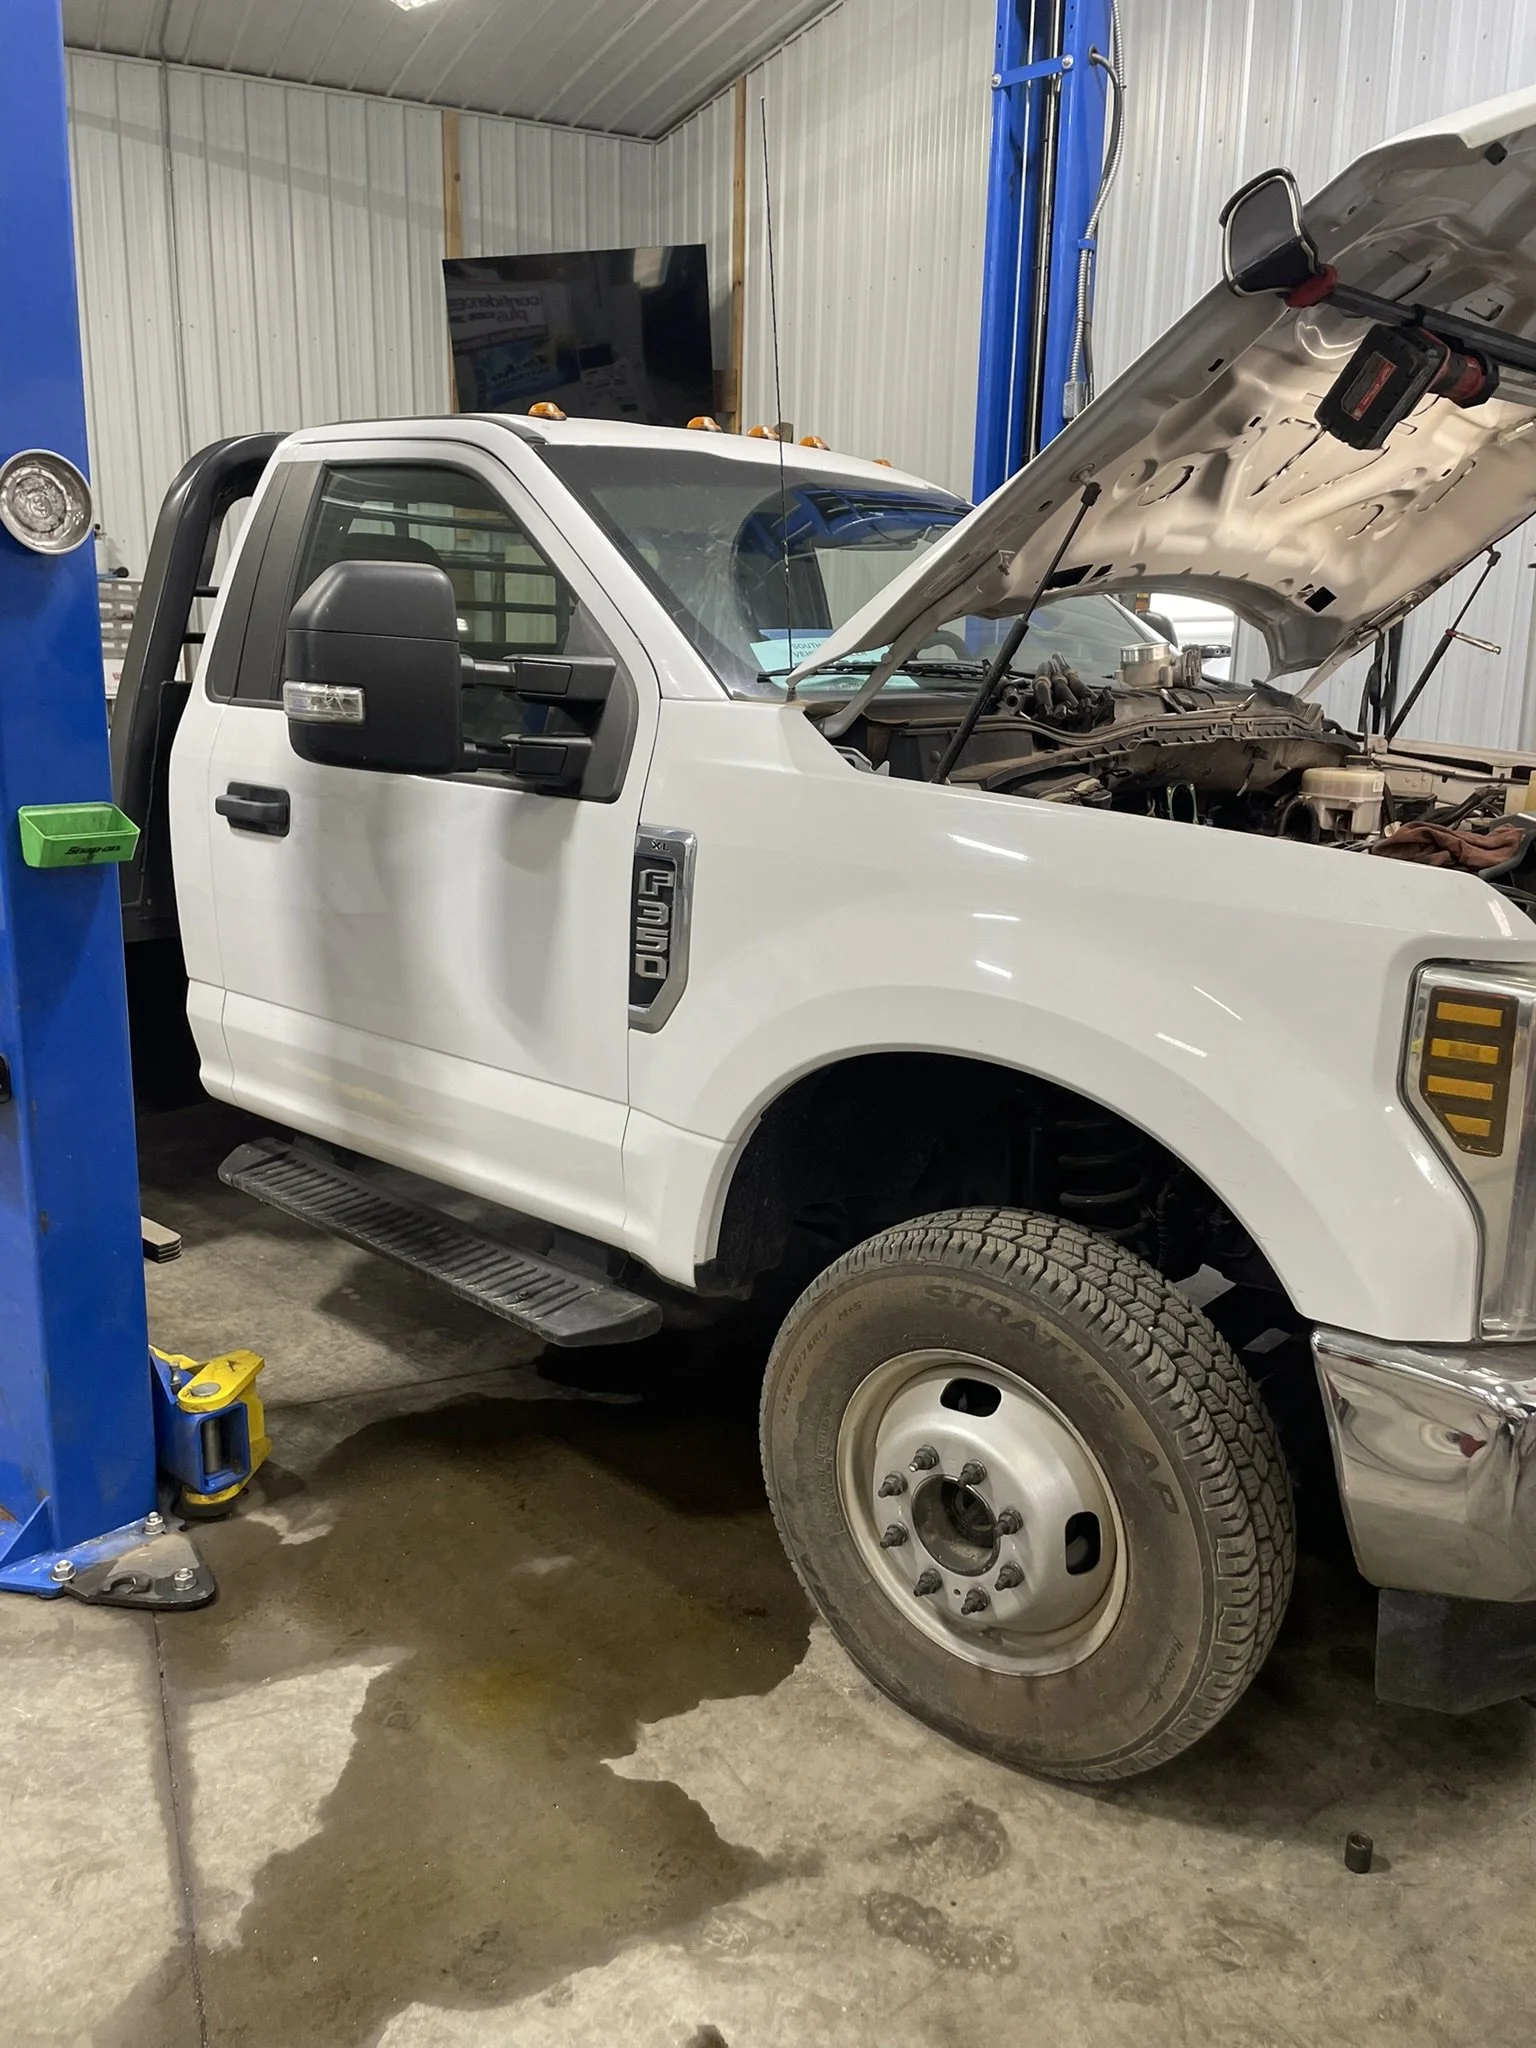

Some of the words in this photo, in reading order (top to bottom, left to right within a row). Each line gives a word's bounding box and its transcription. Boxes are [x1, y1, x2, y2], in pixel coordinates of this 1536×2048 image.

[65, 845, 121, 856] Snap-on
[652, 840, 670, 851] XL
[635, 869, 676, 980] F350
[837, 1300, 863, 1321] M+S
[923, 1284, 1125, 1412] STRATUS
[1118, 1445, 1179, 1514] AP
